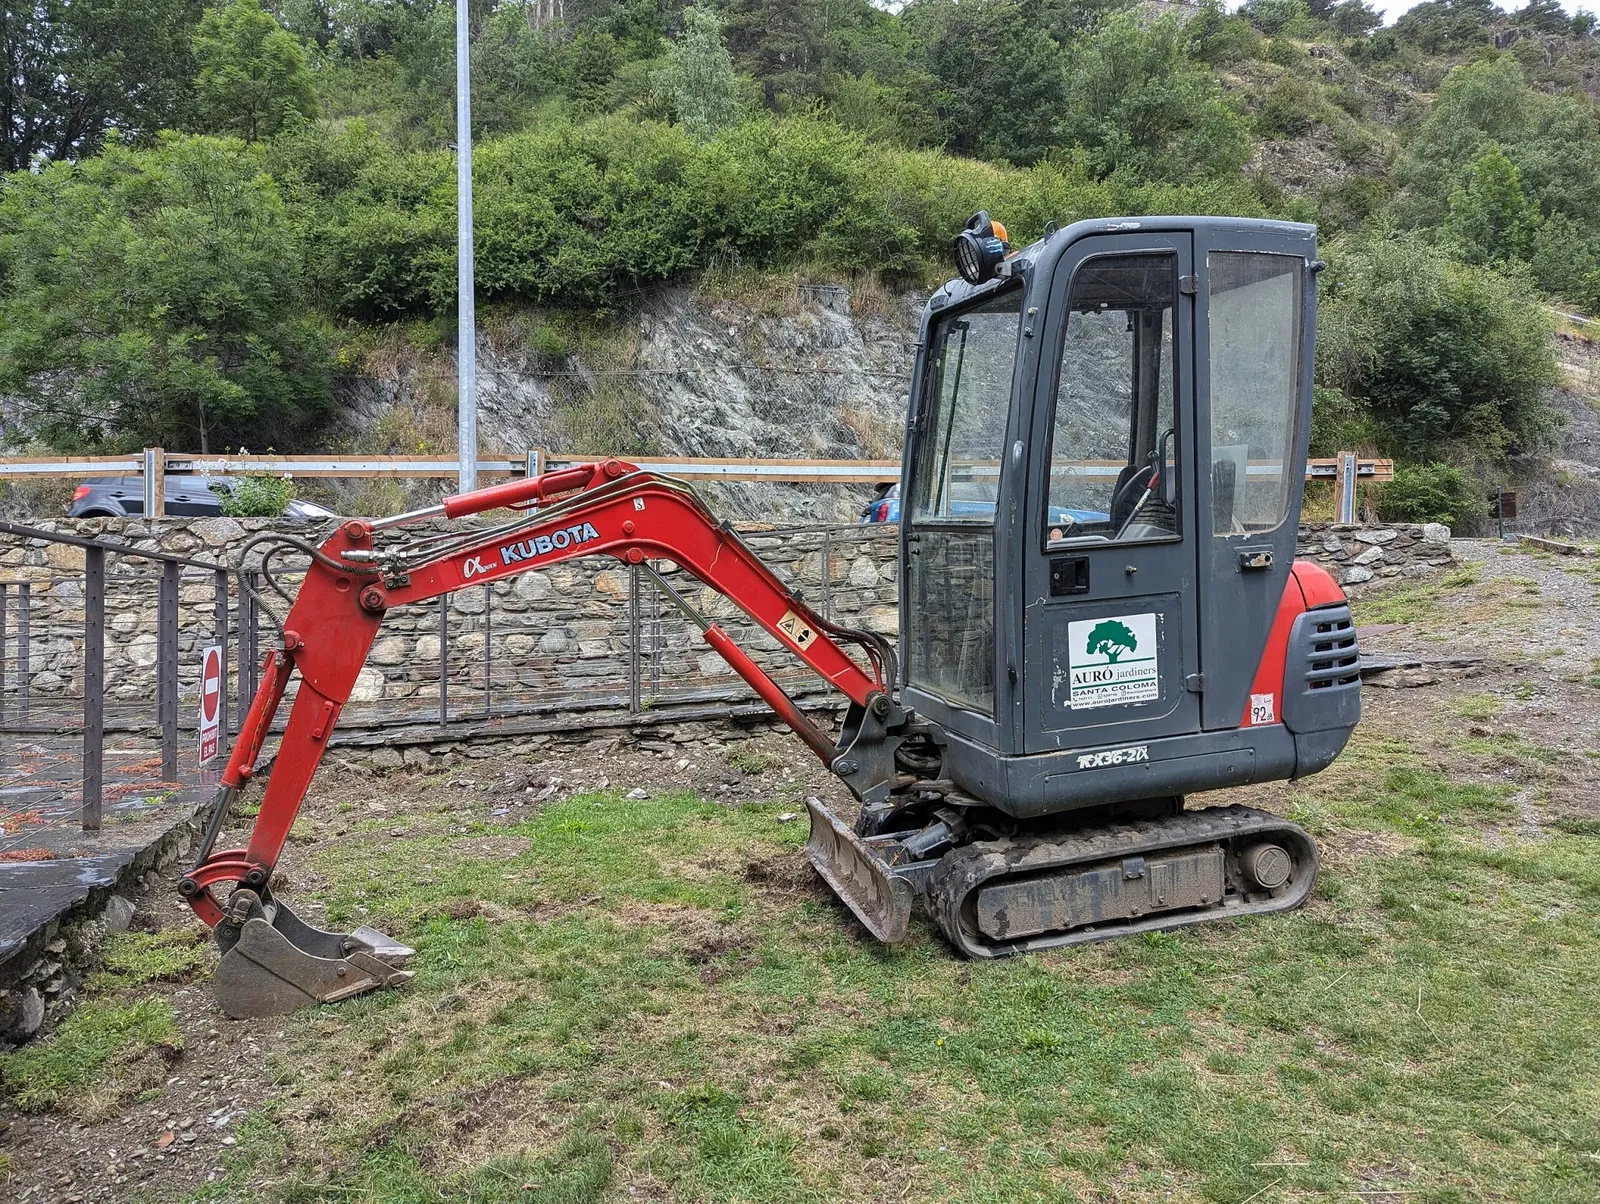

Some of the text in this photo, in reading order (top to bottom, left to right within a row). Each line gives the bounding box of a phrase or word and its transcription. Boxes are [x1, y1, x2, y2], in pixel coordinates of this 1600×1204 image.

[500, 522, 600, 565] KUBOTA
[1072, 666, 1157, 685] AURÓ jardiners
[1072, 681, 1157, 697] SANTA COLOMA
[1072, 693, 1158, 707] www.aurojardiners.com
[1253, 706, 1267, 722] 92
